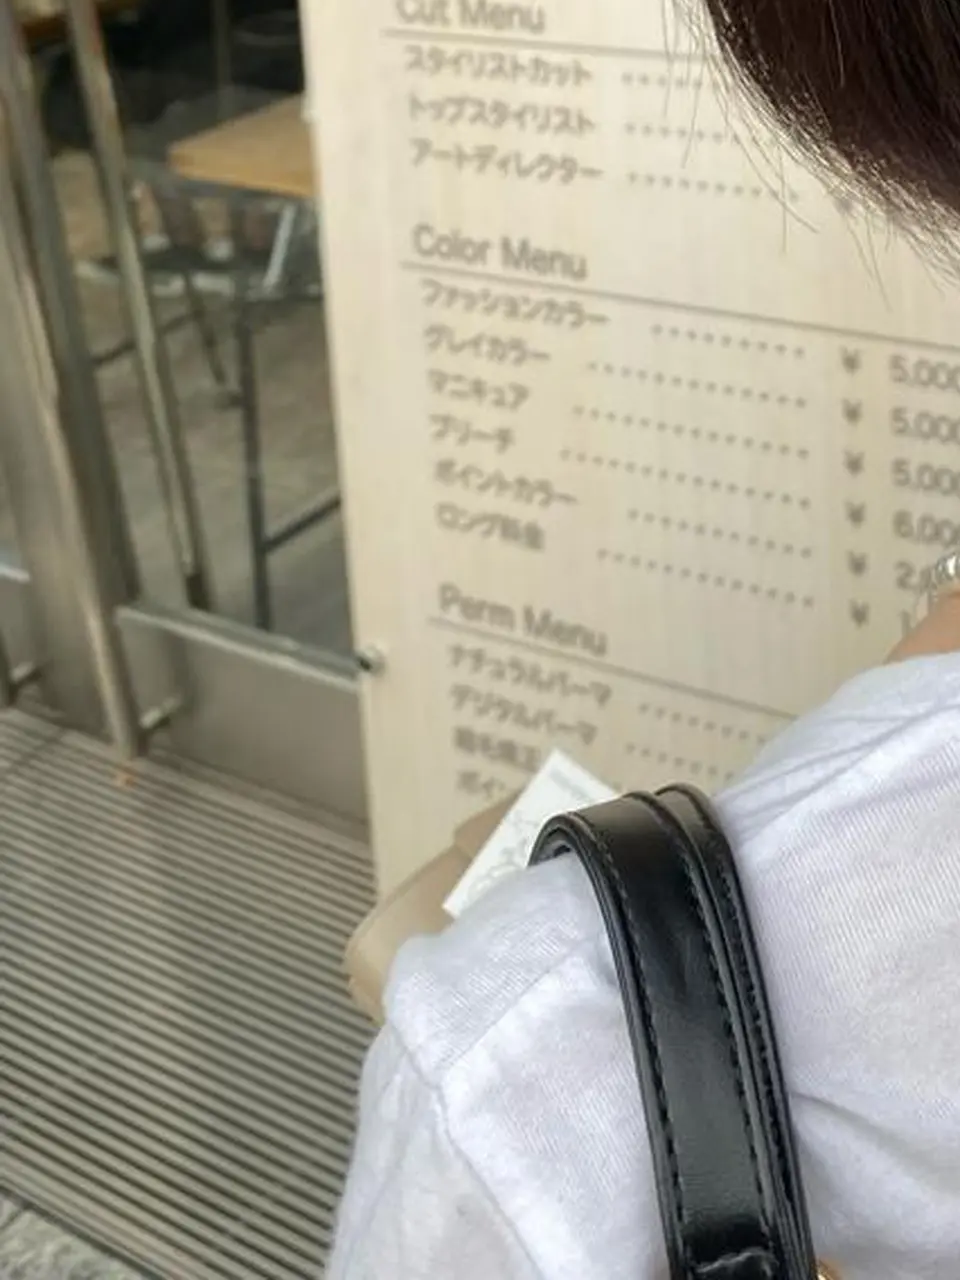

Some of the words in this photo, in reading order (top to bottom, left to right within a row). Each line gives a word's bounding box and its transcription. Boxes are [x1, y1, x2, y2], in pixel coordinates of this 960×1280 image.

[404, 45, 593, 88] スタイリストカット
[408, 94, 596, 134] トップスタイリスト
[409, 138, 604, 185] アートディレクター
[413, 223, 490, 265] Color
[500, 236, 588, 281] Menu
[419, 277, 610, 329] ファッションカラー
[424, 323, 551, 365] グレイカラー
[427, 368, 530, 410] マニキュア
[438, 582, 515, 631] Perm
[523, 604, 607, 657] Menu
